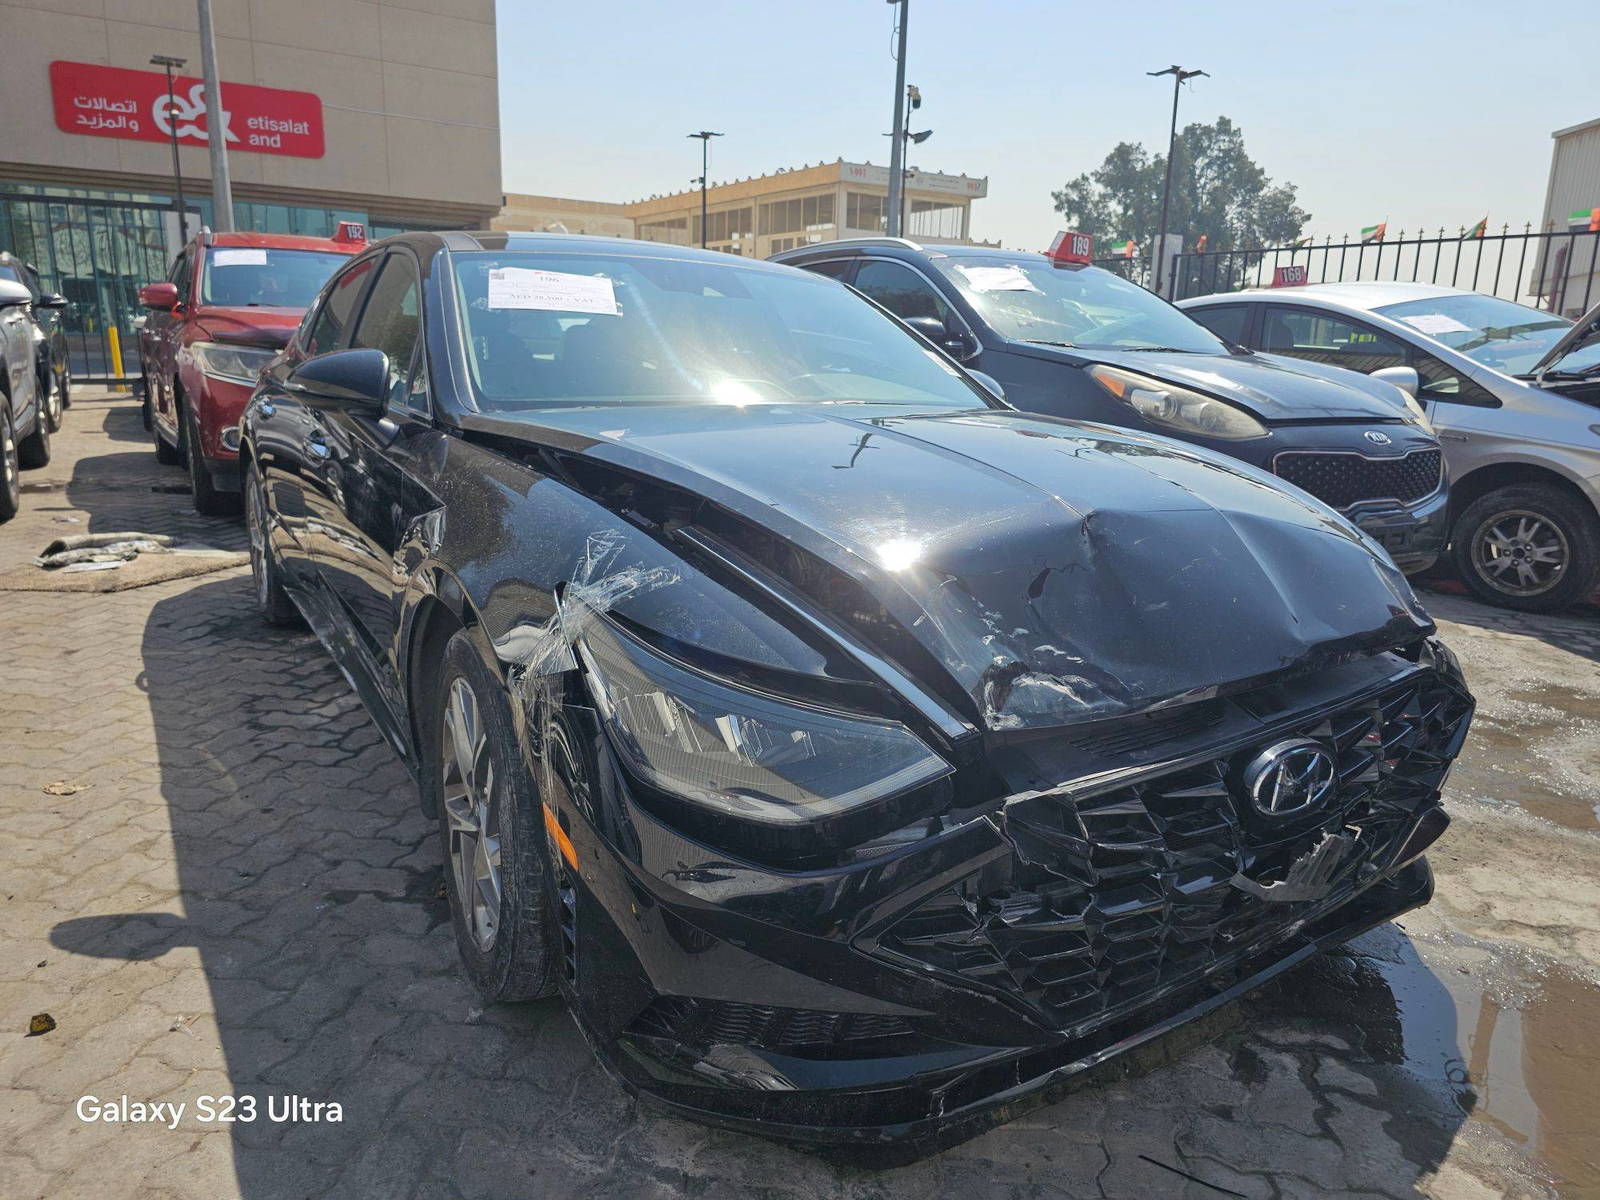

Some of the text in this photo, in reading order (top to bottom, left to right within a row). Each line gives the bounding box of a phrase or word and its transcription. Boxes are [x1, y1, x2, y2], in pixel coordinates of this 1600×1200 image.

[74, 96, 137, 113] اتصالات
[248, 116, 310, 135] etisalat
[249, 133, 281, 148] and
[1072, 235, 1089, 256] 189
[1282, 266, 1301, 282] 168
